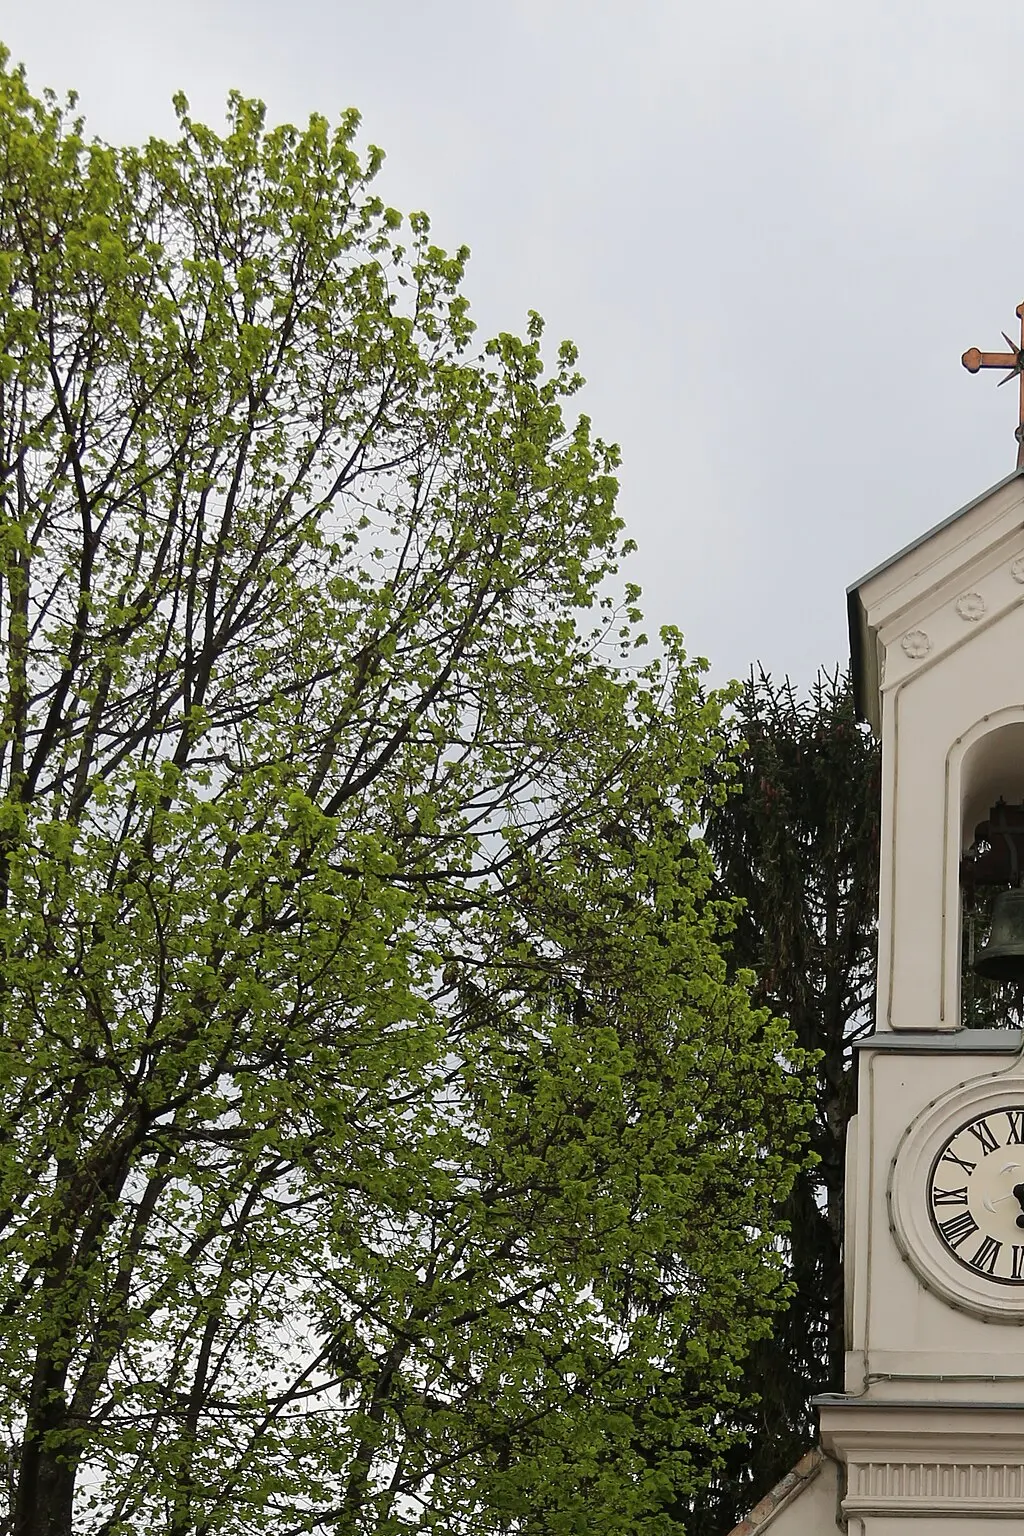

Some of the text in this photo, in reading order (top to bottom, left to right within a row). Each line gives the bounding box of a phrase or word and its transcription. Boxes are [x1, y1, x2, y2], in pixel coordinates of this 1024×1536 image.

[968, 1119, 1001, 1156] XI
[942, 1148, 977, 1176] X
[934, 1186, 968, 1206] IX
[939, 1210, 979, 1250] VIII
[969, 1235, 1003, 1274] VII
